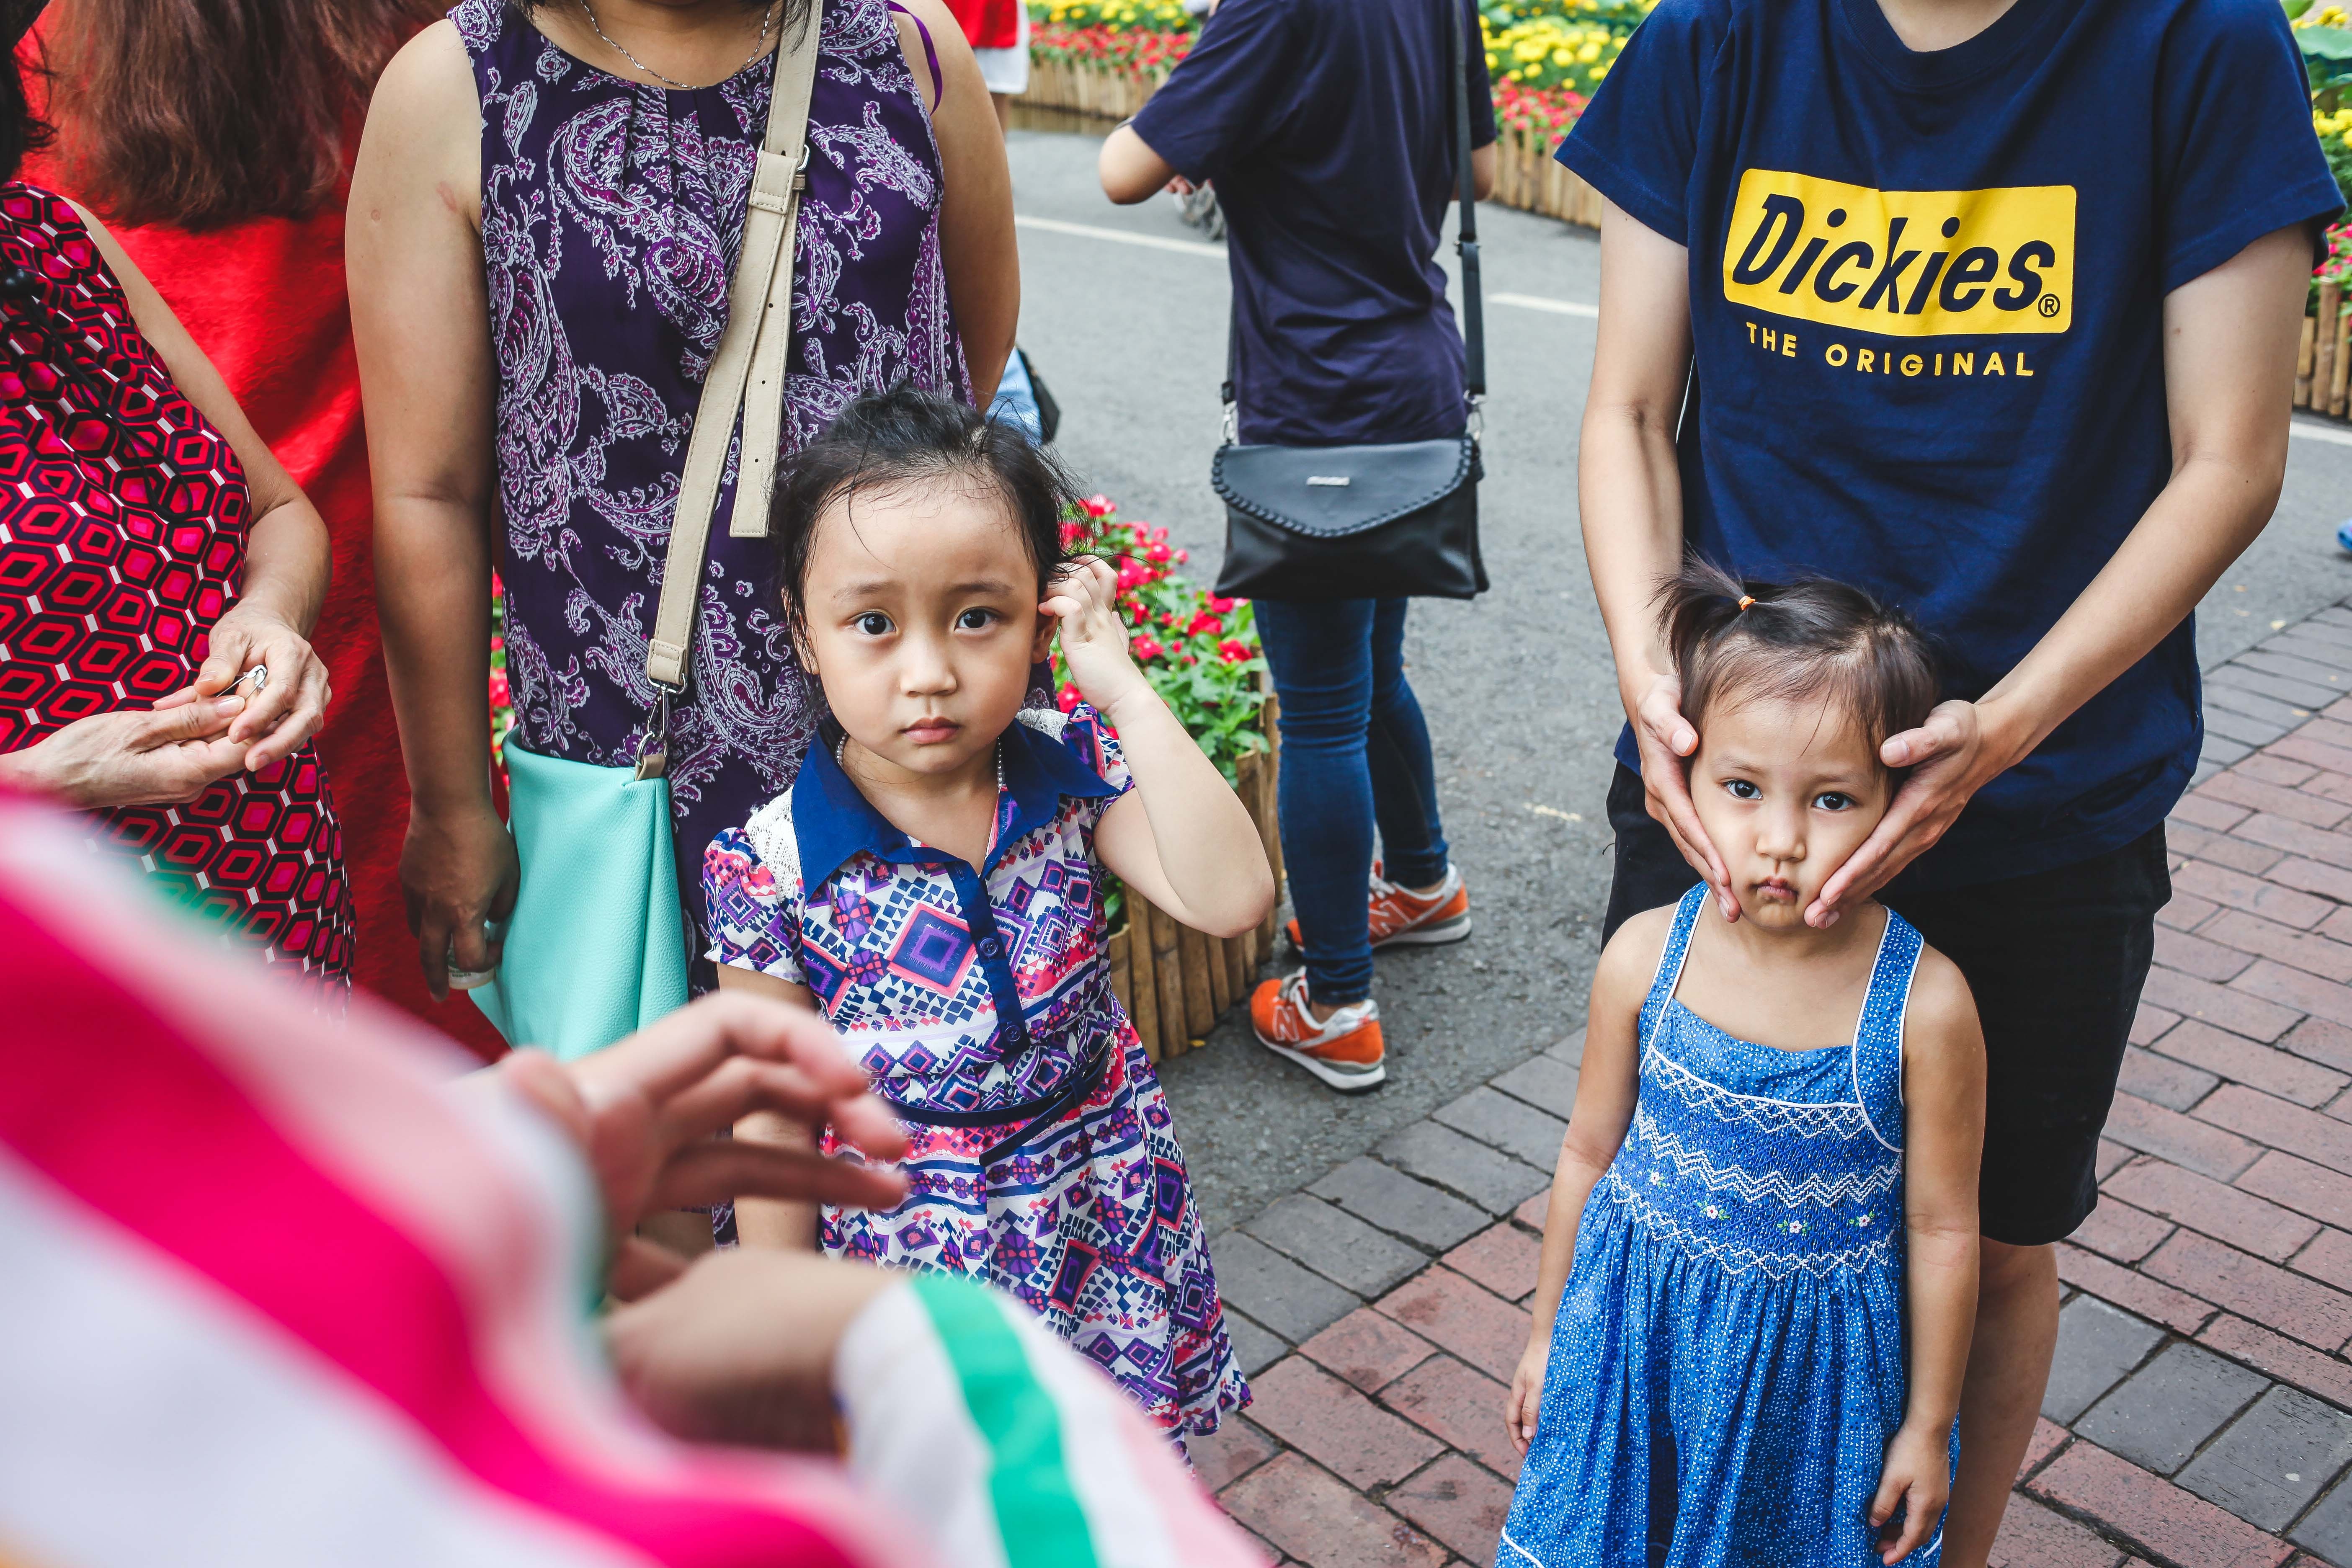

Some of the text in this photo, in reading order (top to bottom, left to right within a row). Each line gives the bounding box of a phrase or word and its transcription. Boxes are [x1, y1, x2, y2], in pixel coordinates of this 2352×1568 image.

[1746, 322, 2034, 377] THE ORIGINAL
[1273, 1005, 1300, 1042] N
